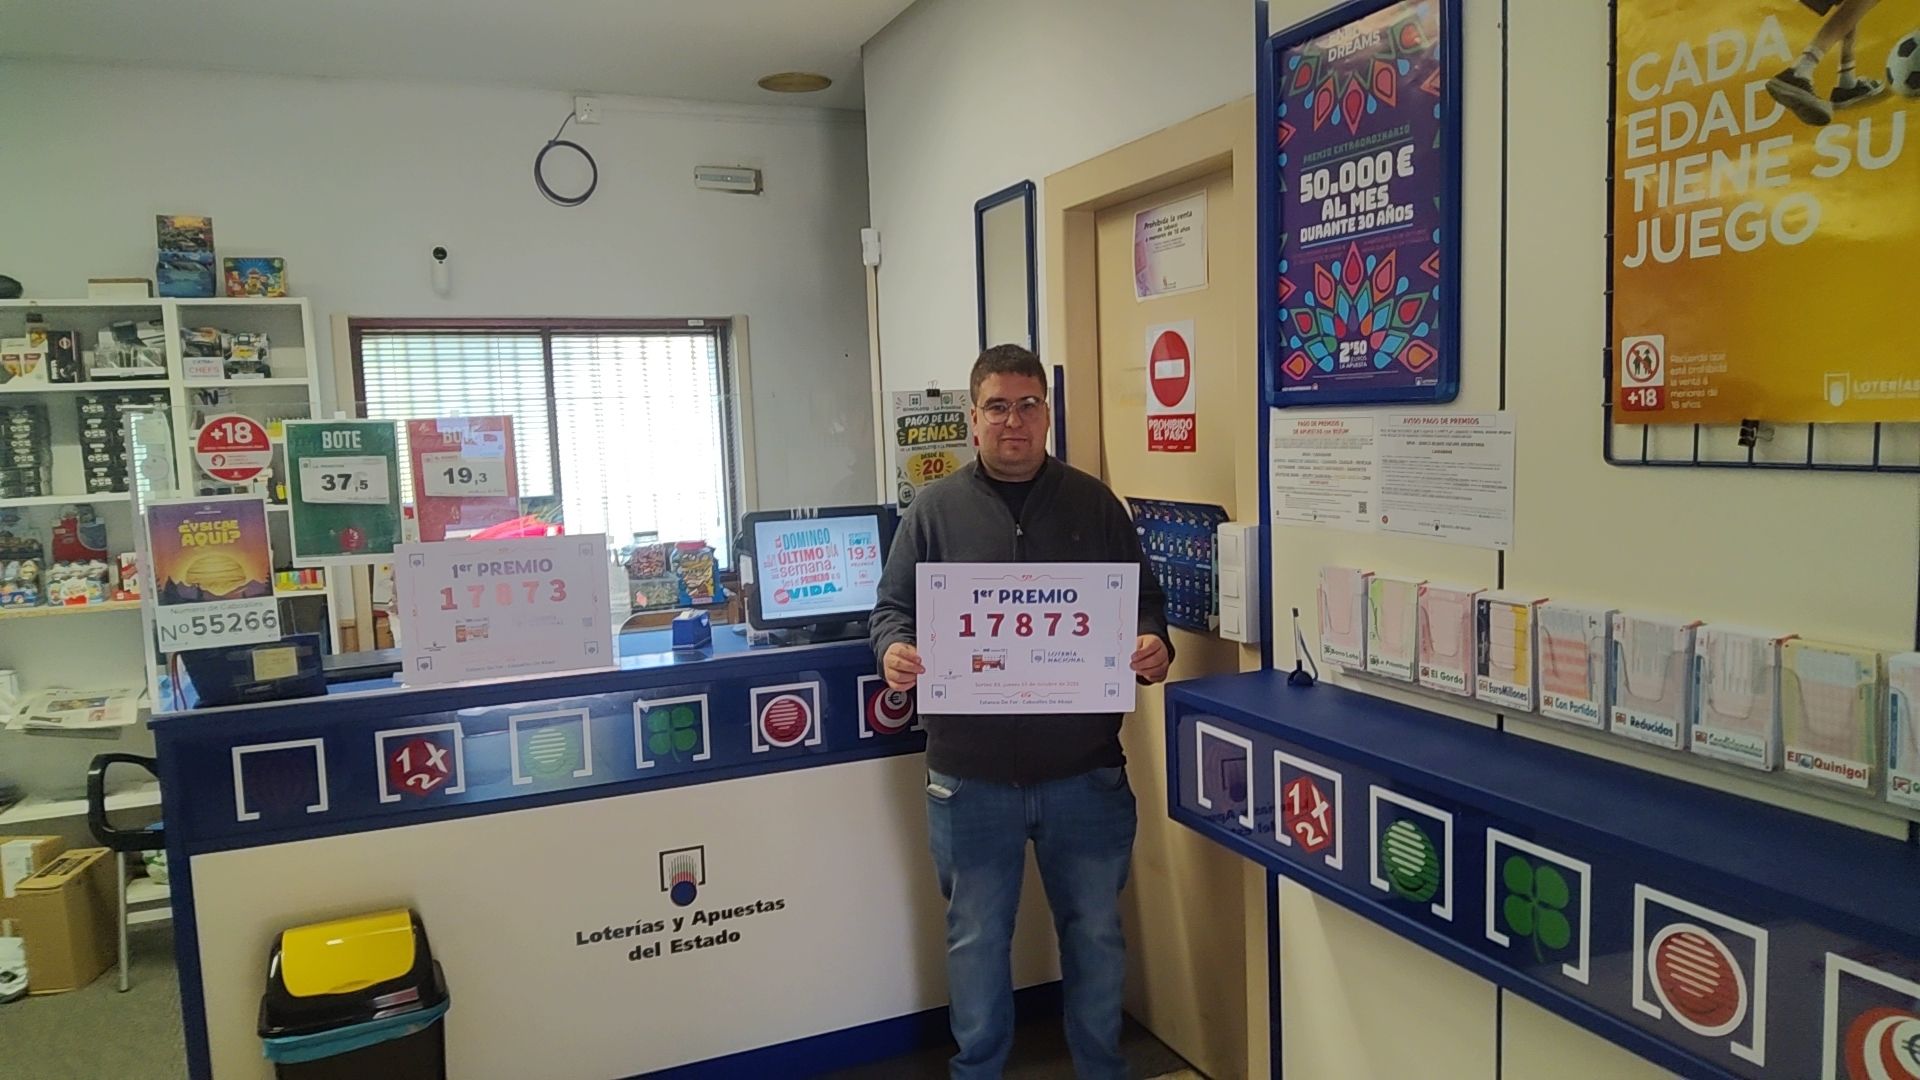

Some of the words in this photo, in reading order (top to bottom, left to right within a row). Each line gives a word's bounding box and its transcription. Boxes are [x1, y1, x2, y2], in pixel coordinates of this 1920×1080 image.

[1328, 30, 1380, 62] DREAMS
[1627, 15, 1792, 101] CADA
[1627, 80, 1786, 159] EDAD
[1333, 124, 1411, 154] EXTRAORDINARIO
[1624, 135, 1793, 213] TIENE
[1810, 110, 1906, 178] SU
[1300, 151, 1393, 203] 50.000
[1396, 144, 1415, 178] €
[1322, 197, 1346, 221] AL
[1351, 184, 1389, 215] MES
[1300, 216, 1356, 243] DURANTE
[1357, 212, 1374, 231] 30
[1376, 204, 1414, 227] AÑOS
[1622, 192, 1822, 268] JUEGO
[1627, 389, 1658, 407] +18
[905, 415, 929, 427] PAGO
[931, 414, 942, 423] DE
[944, 413, 960, 422] LAS
[1149, 418, 1193, 430] PROHIBIDO
[210, 422, 253, 444] +18
[321, 430, 362, 449] BOTE
[907, 422, 957, 444] PEÑAS
[1153, 430, 1163, 440] EL
[1164, 430, 1188, 441] PASO
[443, 467, 487, 485] 19,3
[922, 459, 944, 475] 20
[321, 474, 368, 492] 37,5
[782, 528, 830, 550] DOMINGO
[777, 547, 824, 565] ÚLTIMO
[452, 564, 473, 579] 1er
[477, 558, 553, 577] PREMIO
[972, 588, 993, 604] 1er
[998, 589, 1078, 604] PREMIO
[959, 612, 1090, 638] 17873
[1431, 669, 1438, 679] El
[1440, 671, 1463, 685] Gordo
[1488, 681, 1528, 701] EuroMillones
[1554, 697, 1571, 711] Con
[1787, 750, 1799, 763] El
[1814, 758, 1867, 781] Quinigol
[575, 919, 664, 946] Loterías
[672, 916, 684, 932] y
[692, 899, 786, 926] Apuestas
[628, 942, 661, 961] del
[670, 929, 741, 954] Estado
